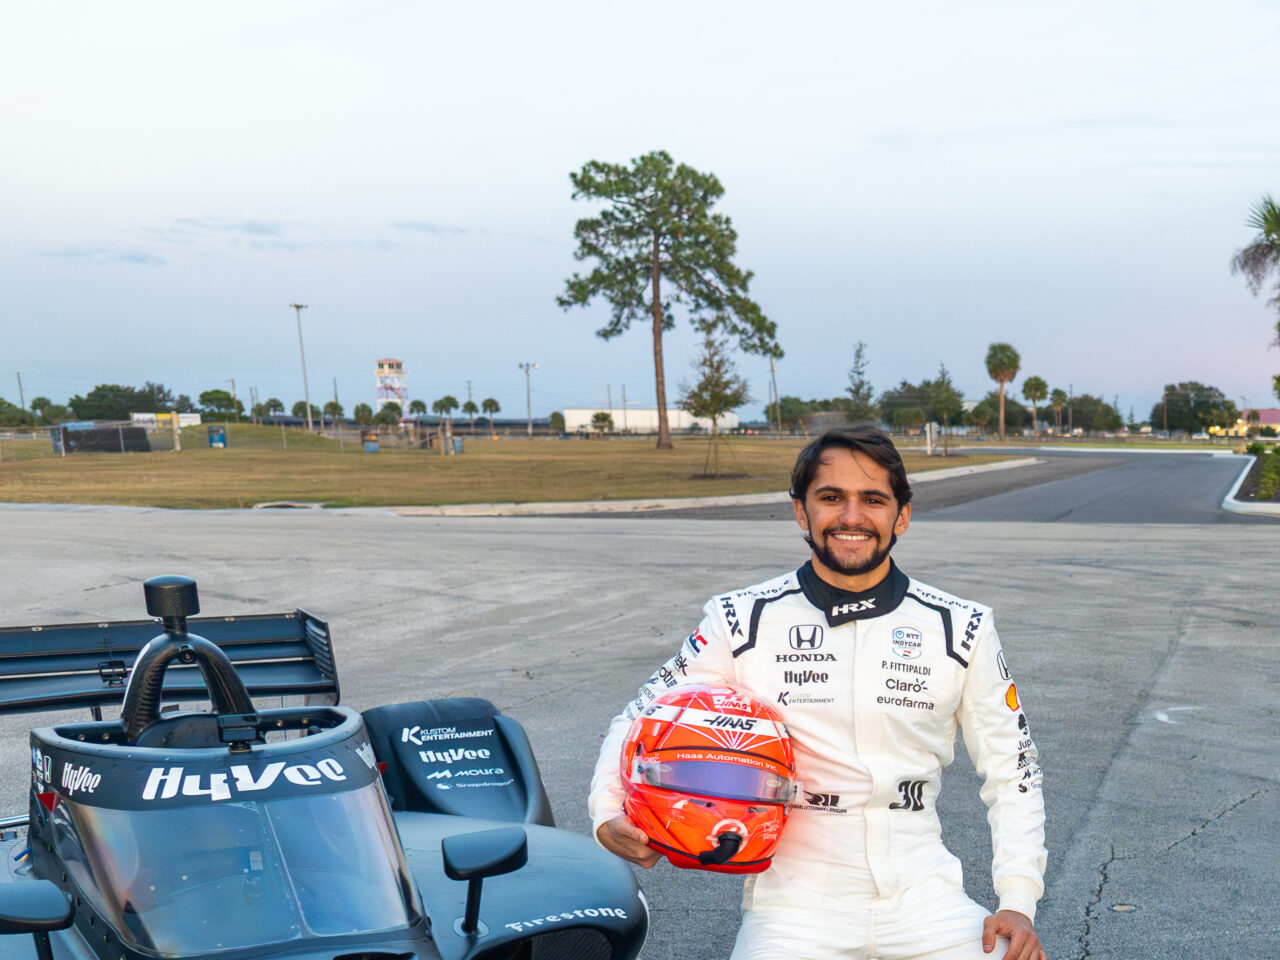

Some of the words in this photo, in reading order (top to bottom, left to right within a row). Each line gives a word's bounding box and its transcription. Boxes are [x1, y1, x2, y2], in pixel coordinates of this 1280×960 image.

[831, 598, 877, 617] HRX
[720, 597, 744, 638] HRX
[906, 632, 920, 640] NTT
[960, 608, 984, 652] HRX
[892, 639, 922, 649] INDYCAR
[775, 653, 838, 663] HONDA
[881, 660, 889, 670] P.
[889, 662, 932, 677] FITTIPALDI
[784, 670, 830, 687] HyVee
[885, 678, 928, 693] Claro
[876, 695, 936, 711] eurofarma
[420, 726, 457, 736] KUSTOM
[703, 715, 758, 732] HAAS
[421, 729, 495, 742] ENTERTAINMENT
[418, 748, 491, 764] HyVee
[706, 753, 764, 768] Automation
[765, 762, 778, 772] Inc.
[62, 762, 102, 796] HyVee
[142, 757, 347, 801] HyVee
[455, 779, 515, 789] Snapdragon
[888, 780, 929, 812] 30
[505, 905, 629, 933] Firestone
